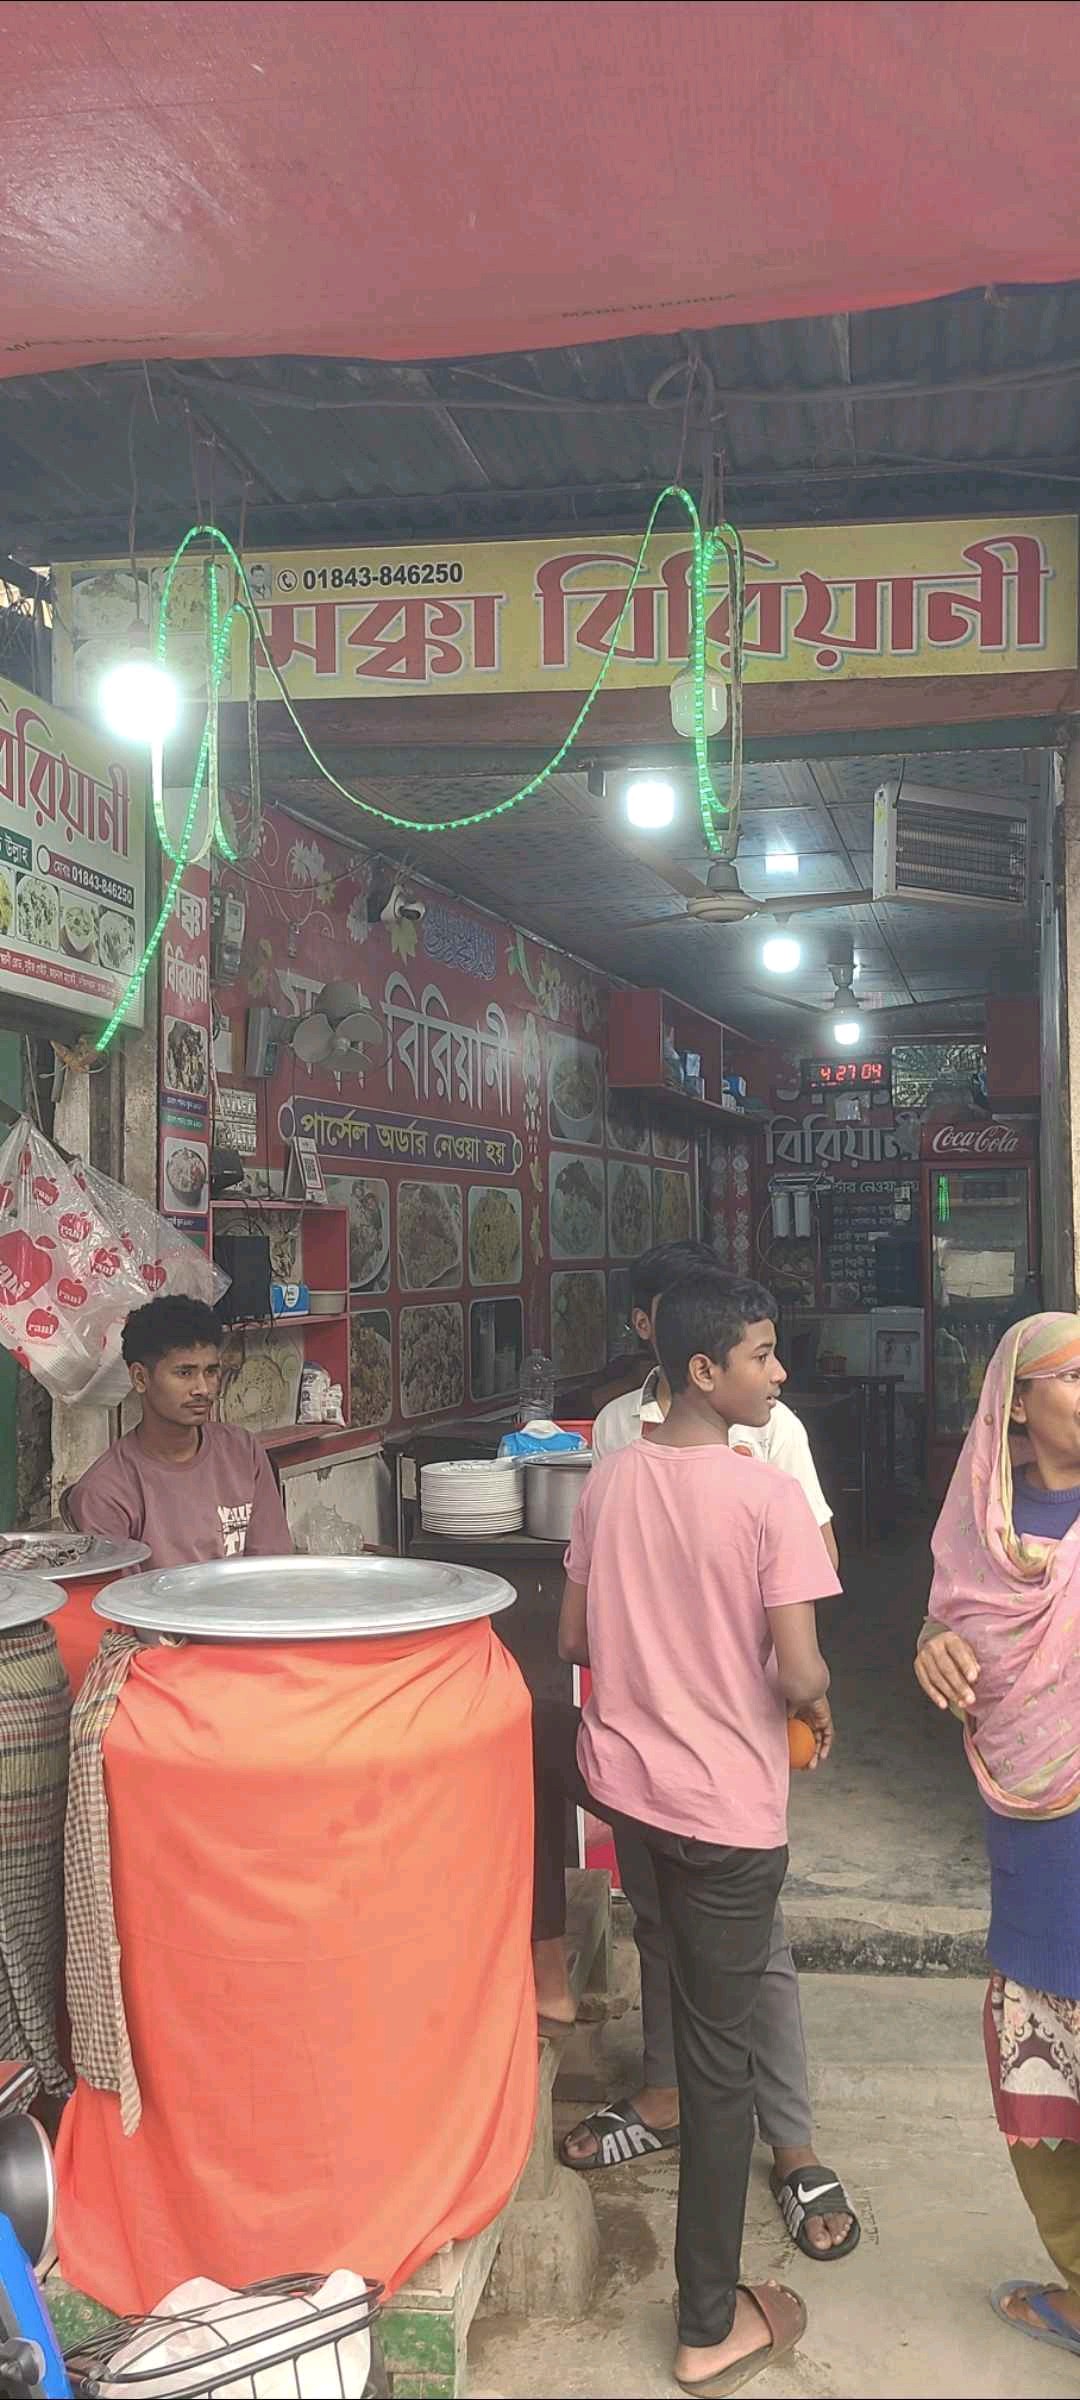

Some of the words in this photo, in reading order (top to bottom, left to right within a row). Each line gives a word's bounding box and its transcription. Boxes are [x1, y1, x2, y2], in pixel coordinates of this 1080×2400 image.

[302, 562, 464, 591] 01843-846250
[535, 534, 1051, 669] বিরিয়ানী
[71, 865, 133, 904] 01843-846250
[379, 970, 517, 1117] বিরিয়ানী
[819, 1066, 831, 1081] 4
[835, 1063, 857, 1082] 27
[861, 1063, 883, 1080] 04
[300, 1109, 370, 1150] পার্সেল
[376, 1119, 429, 1156] অর্ডার
[433, 1132, 480, 1164] নেওয়া
[484, 1137, 507, 1166] হয়
[58, 1288, 82, 1305] rani
[27, 1322, 55, 1336] rani
[601, 2124, 662, 2165] AIR
